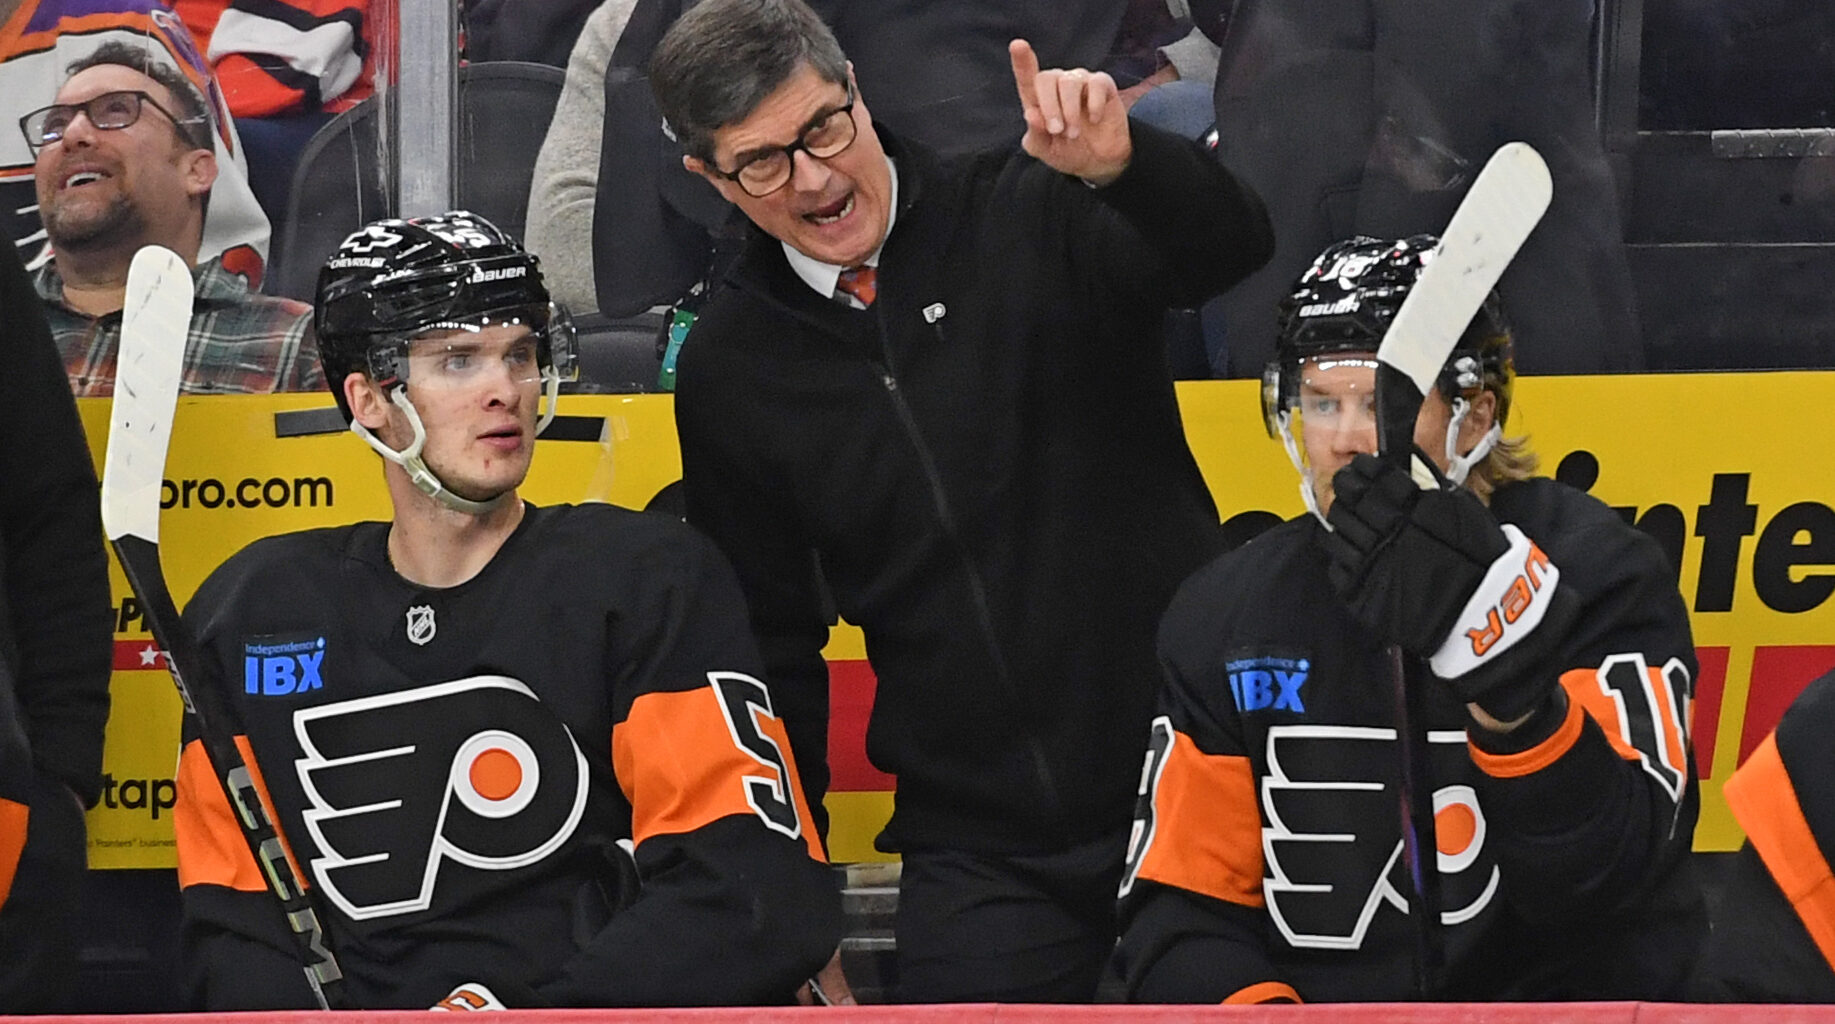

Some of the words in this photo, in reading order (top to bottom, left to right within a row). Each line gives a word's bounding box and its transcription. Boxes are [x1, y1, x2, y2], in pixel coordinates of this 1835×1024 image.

[330, 257, 386, 269] CHEVROLET
[472, 266, 526, 283] BAUER
[158, 477, 334, 509] pro.com
[1465, 538, 1551, 656] UER
[245, 650, 324, 696] IBX
[1229, 670, 1308, 713] IBX
[227, 766, 343, 984] CCM
